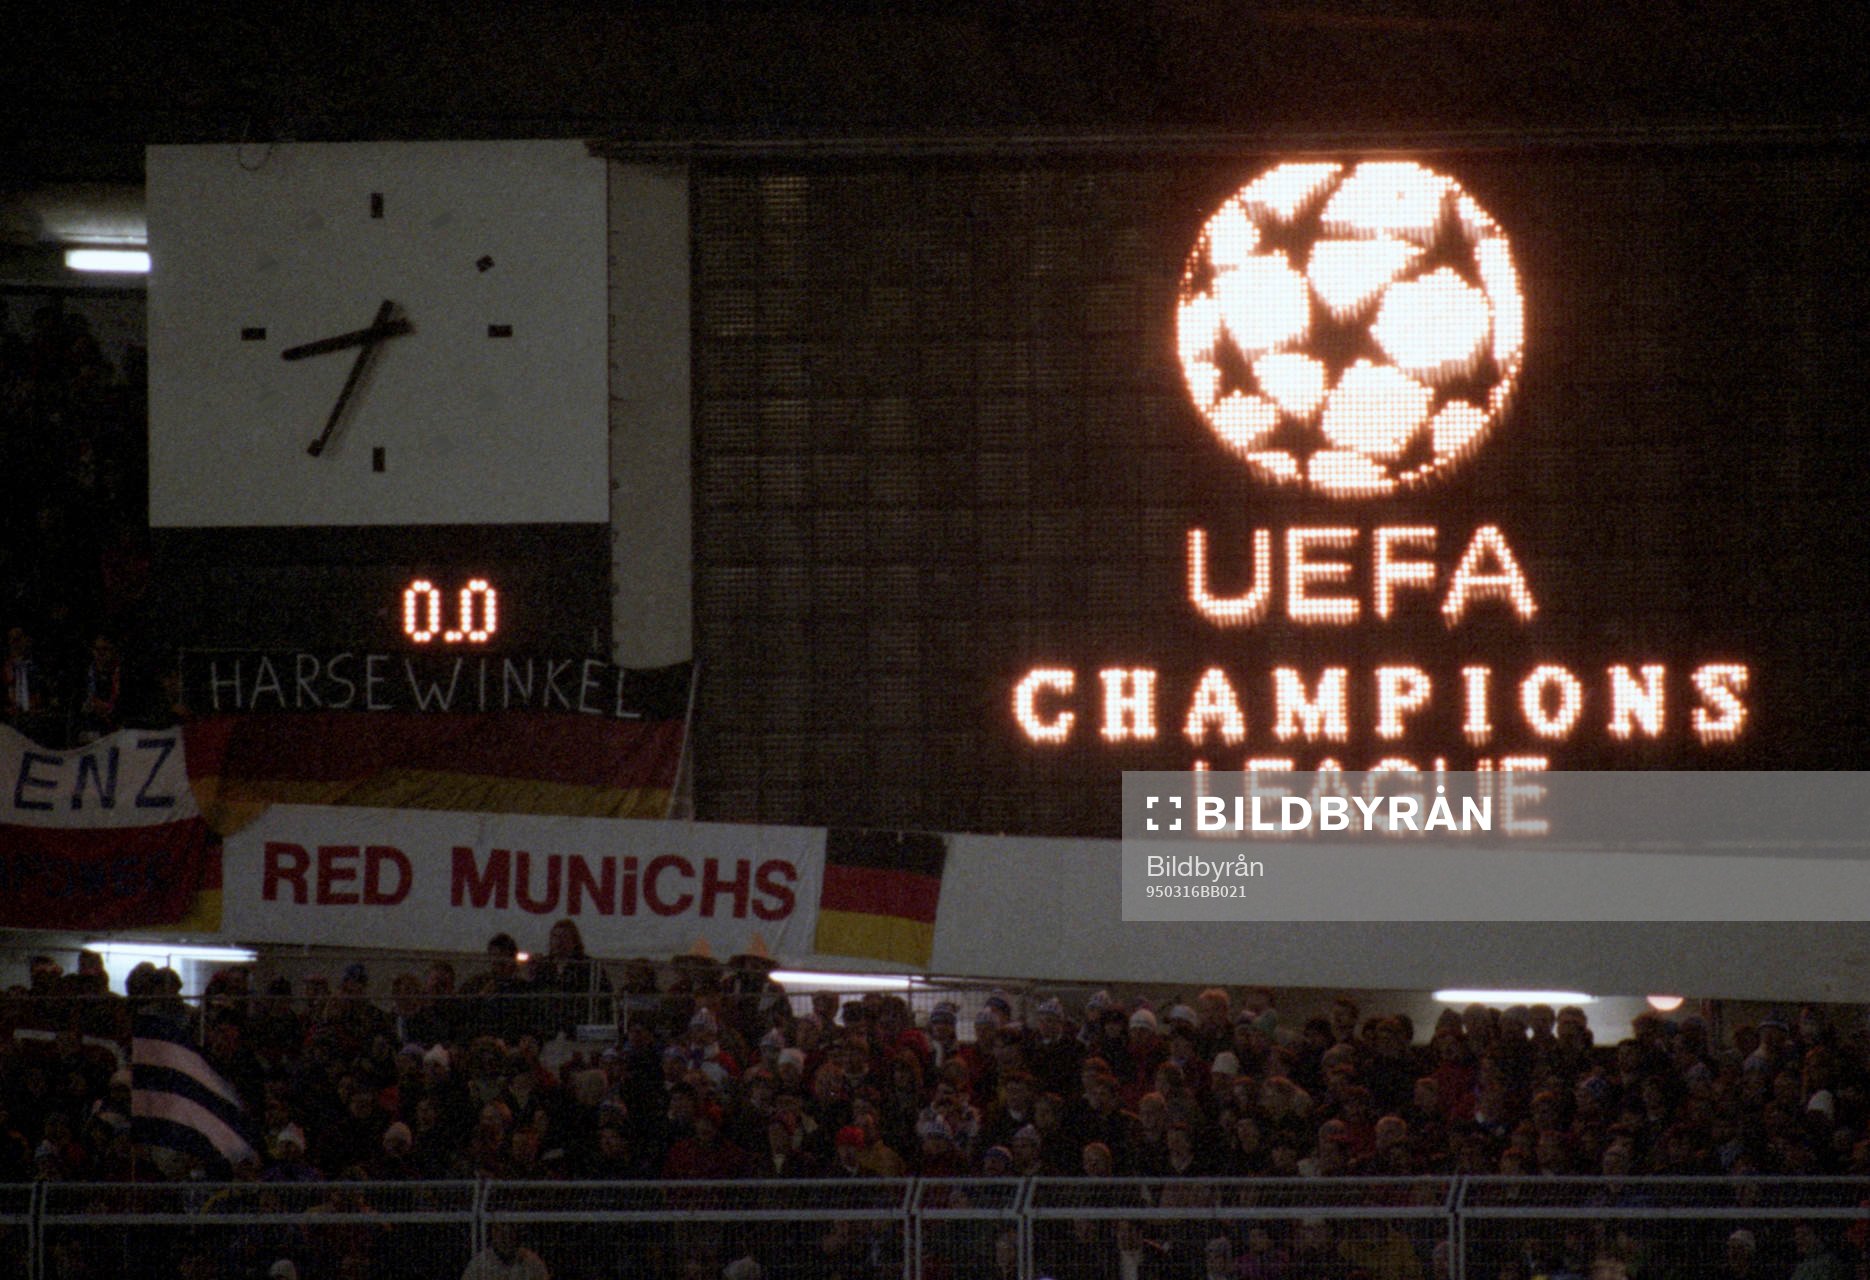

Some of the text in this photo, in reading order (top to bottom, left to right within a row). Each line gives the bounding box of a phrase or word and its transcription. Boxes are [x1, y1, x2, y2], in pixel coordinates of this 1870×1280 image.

[402, 578, 498, 645] 0.0
[1186, 524, 1539, 628] UEFA
[210, 653, 642, 719] HARSEWINKEL
[1011, 664, 1750, 745] CHAMPIONS
[13, 736, 176, 812] ENZ
[1193, 756, 1550, 837] LEAGUE
[261, 841, 414, 907] RED
